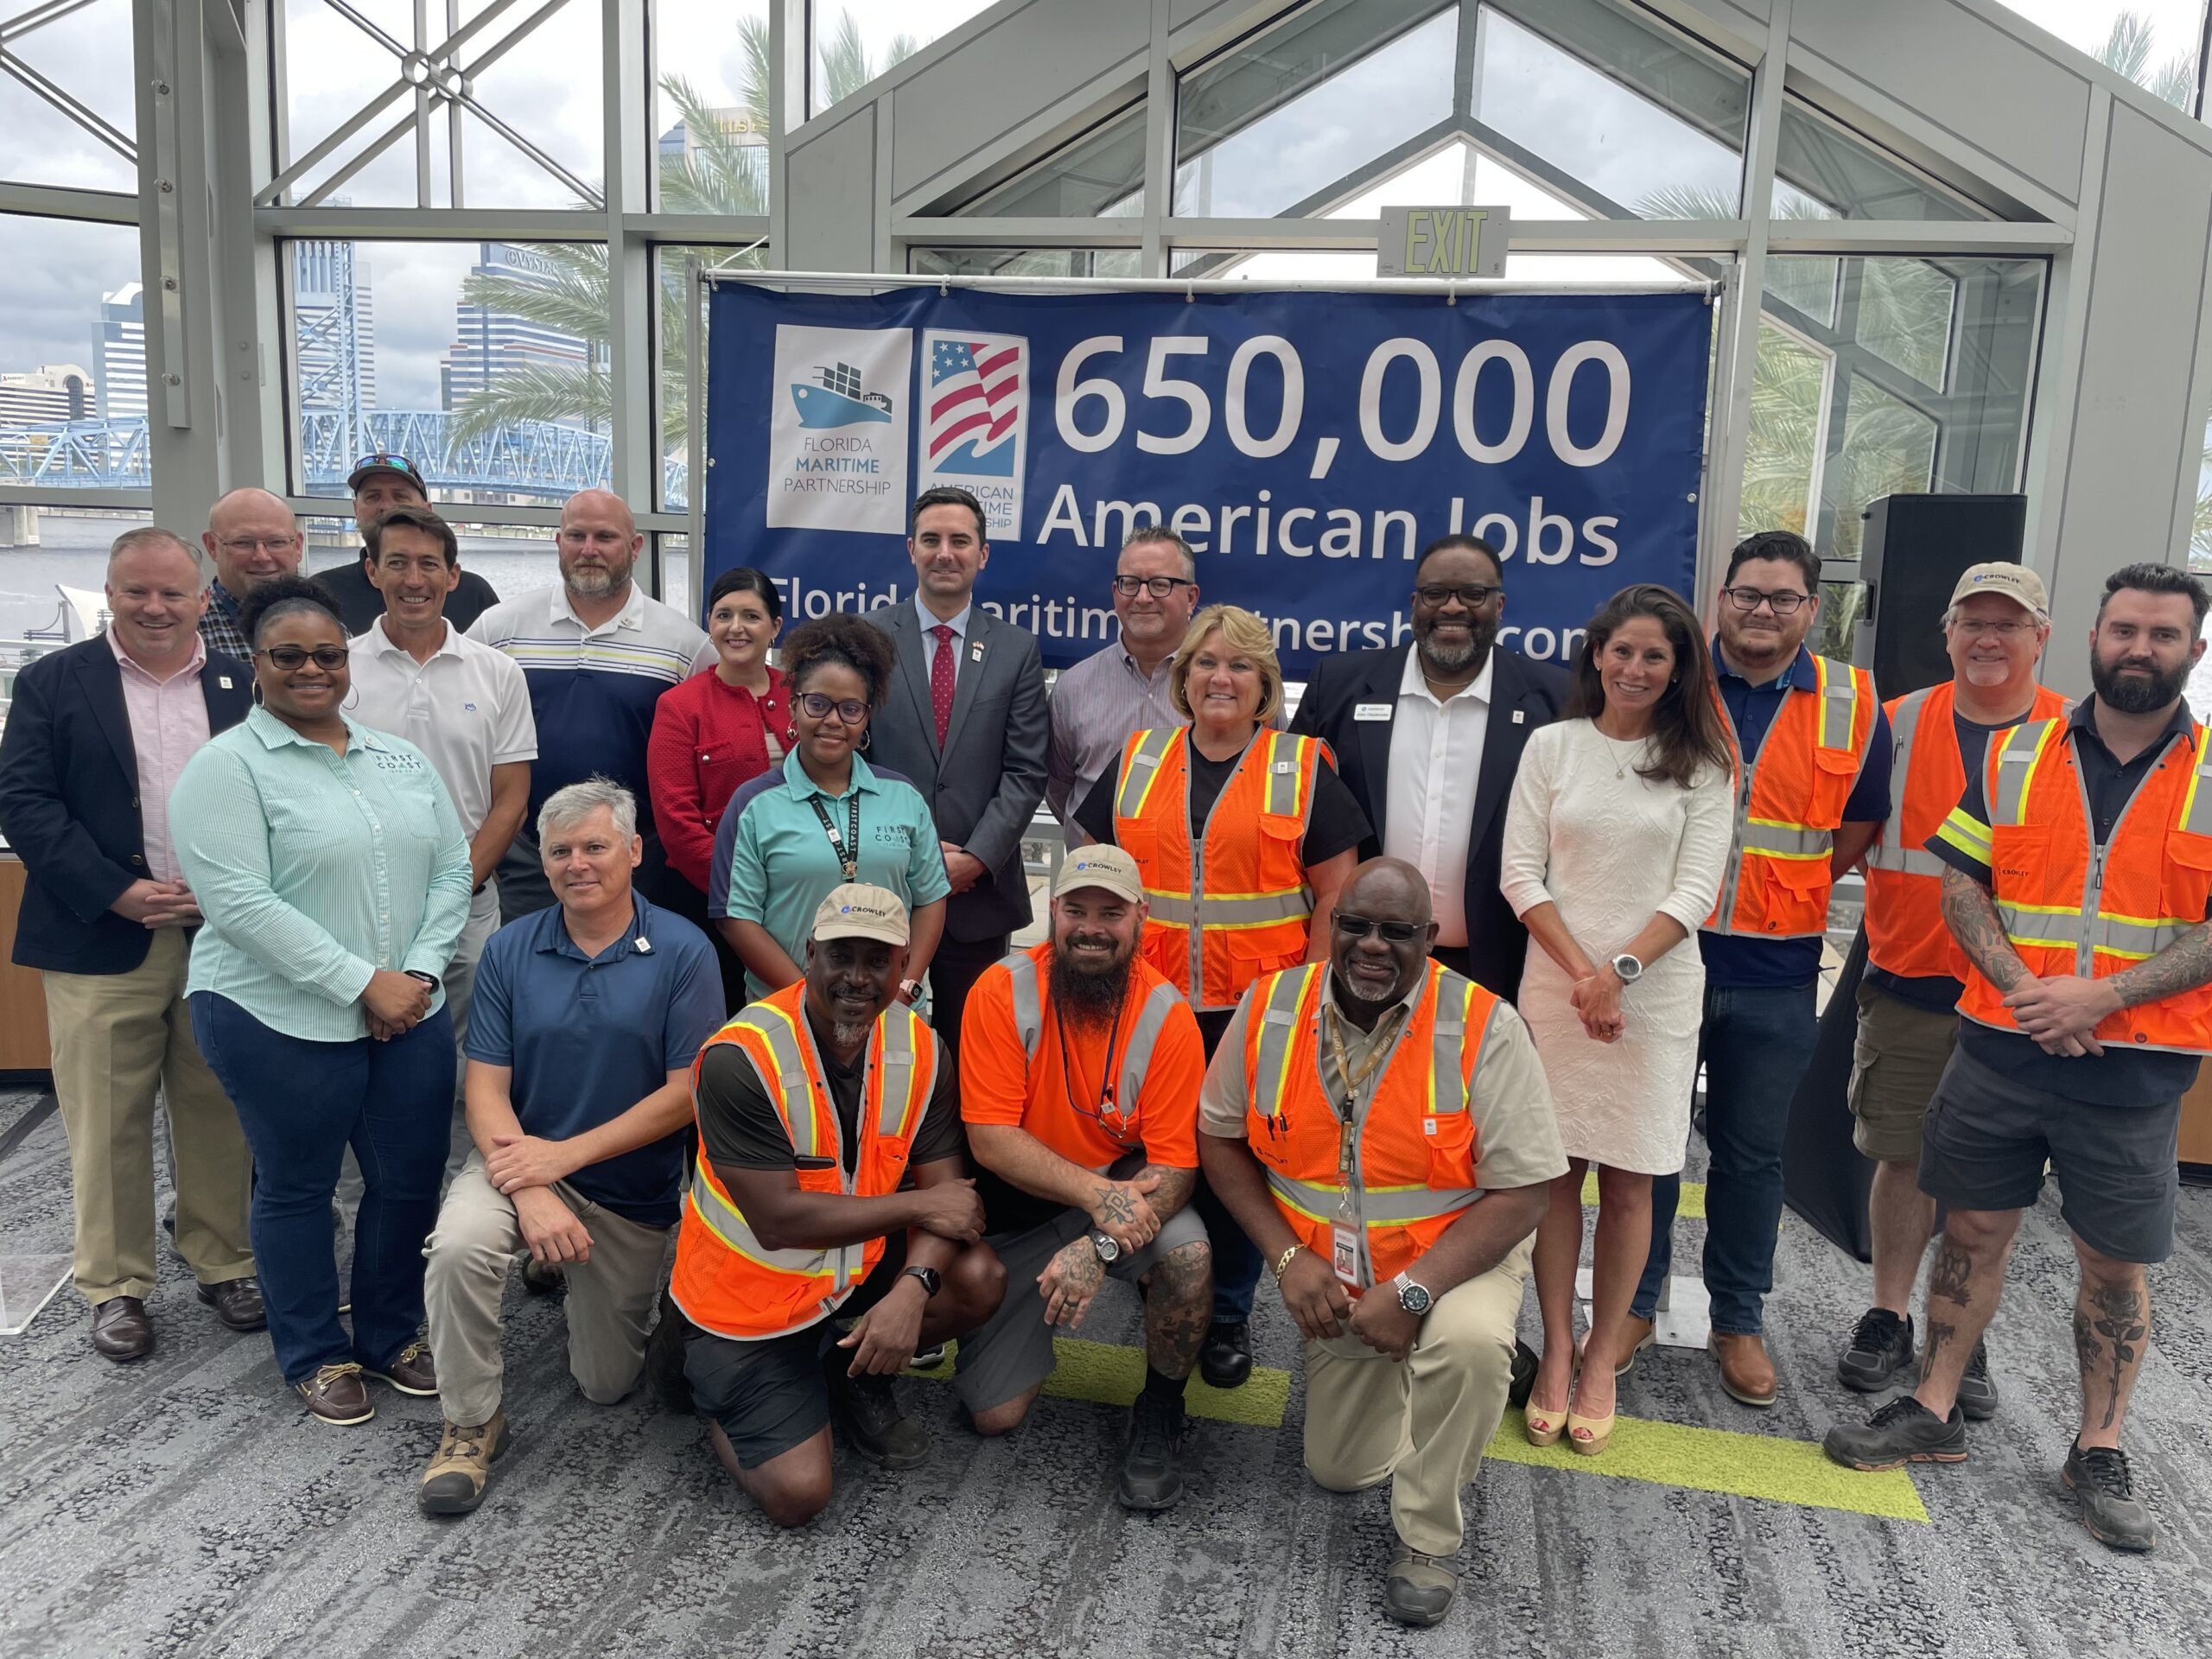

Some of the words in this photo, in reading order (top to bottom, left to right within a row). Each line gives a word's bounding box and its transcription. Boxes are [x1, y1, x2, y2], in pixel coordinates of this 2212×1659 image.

[1404, 210, 1489, 273] EXIT
[1055, 335, 1630, 479] 650,000
[804, 437, 872, 452] FLORIDA
[796, 456, 880, 474] MARITIME
[785, 478, 891, 495] PARTNERSHIP
[931, 483, 1014, 499] ARICAN
[1036, 484, 1417, 560] American
[1984, 574, 2020, 584] CROWLEY
[874, 834, 908, 843] COST
[1088, 862, 1122, 874] CROWLEY
[851, 906, 887, 918] CROWLEY
